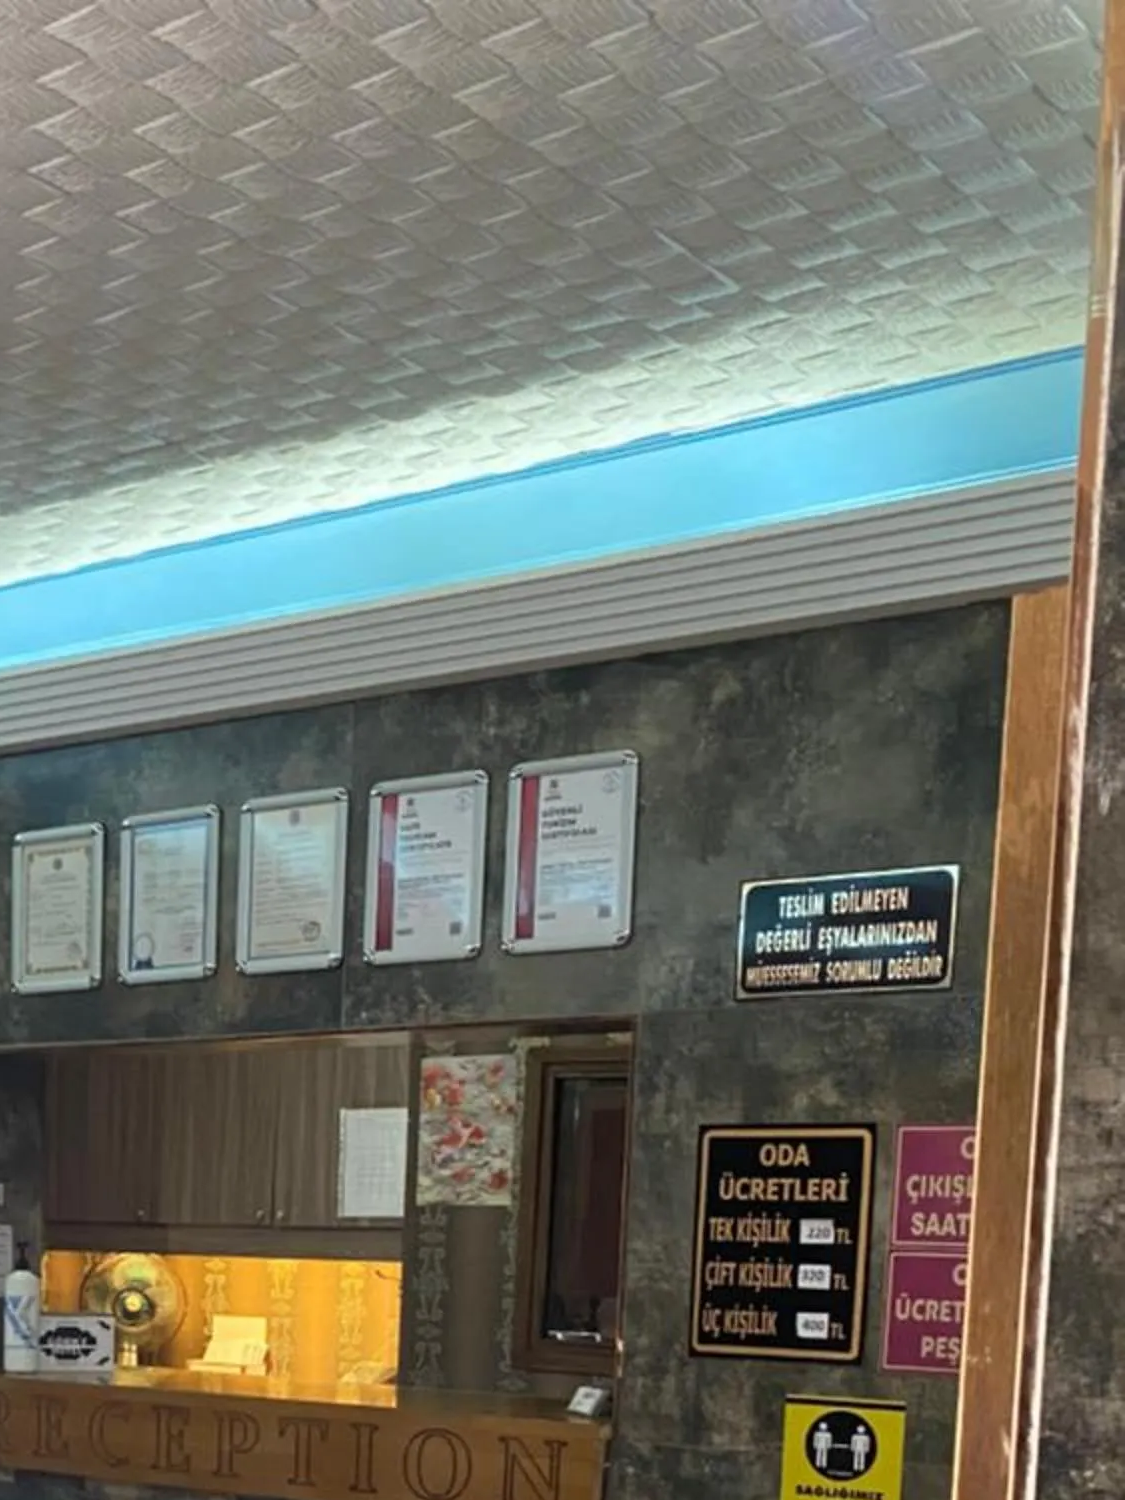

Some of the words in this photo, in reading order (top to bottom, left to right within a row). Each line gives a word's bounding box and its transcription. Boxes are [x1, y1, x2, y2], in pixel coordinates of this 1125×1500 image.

[779, 888, 824, 918] TESLİM
[832, 884, 910, 915] EDİLMEYEN
[755, 922, 812, 954] DEĞERLİ
[818, 920, 938, 956] EŞYALARINIZDAN
[826, 958, 882, 983] SORUMLU
[887, 951, 943, 980] DEĞİLDİR
[759, 1143, 811, 1168] ODA
[719, 1171, 850, 1202] ÜCRETLERİ
[906, 1174, 973, 1205] ÇIKIŞ
[709, 1217, 732, 1241] TEK
[736, 1211, 791, 1248] KİŞİLİK
[836, 1227, 853, 1245] TL
[705, 1256, 735, 1291] ÇİFT
[739, 1257, 794, 1291] KİŞİLİK
[833, 1273, 850, 1291] TL
[702, 1305, 721, 1340] ÜÇ
[724, 1305, 778, 1340] KİŞİLİK
[830, 1322, 847, 1340] TL
